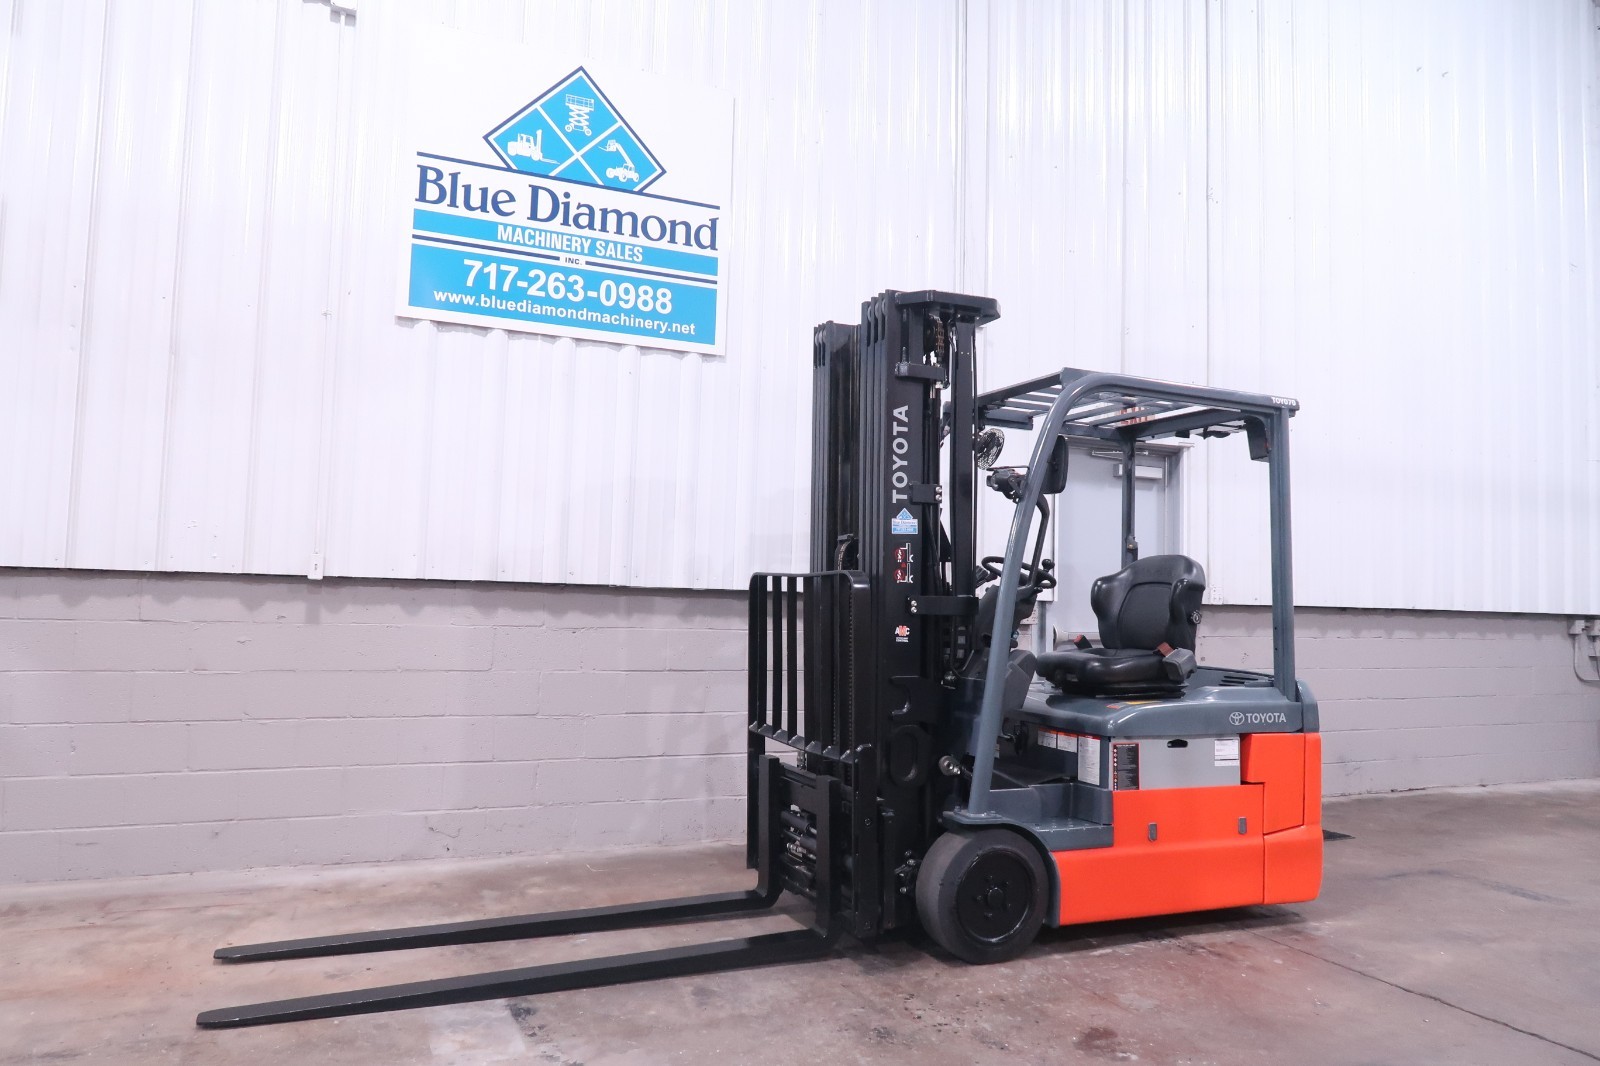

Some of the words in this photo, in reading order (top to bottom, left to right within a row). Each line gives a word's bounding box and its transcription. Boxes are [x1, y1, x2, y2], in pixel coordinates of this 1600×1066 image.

[415, 164, 516, 217] Blue
[527, 184, 720, 251] Diamond
[497, 224, 591, 254] MACHINERY
[595, 240, 644, 263] SALES
[564, 257, 583, 266] INC.
[463, 258, 673, 315] 717-263-0988
[433, 290, 696, 335] www.bluediamondmachinery.net
[892, 405, 909, 504] TOYOTA
[1245, 713, 1287, 724] TOYOTA
